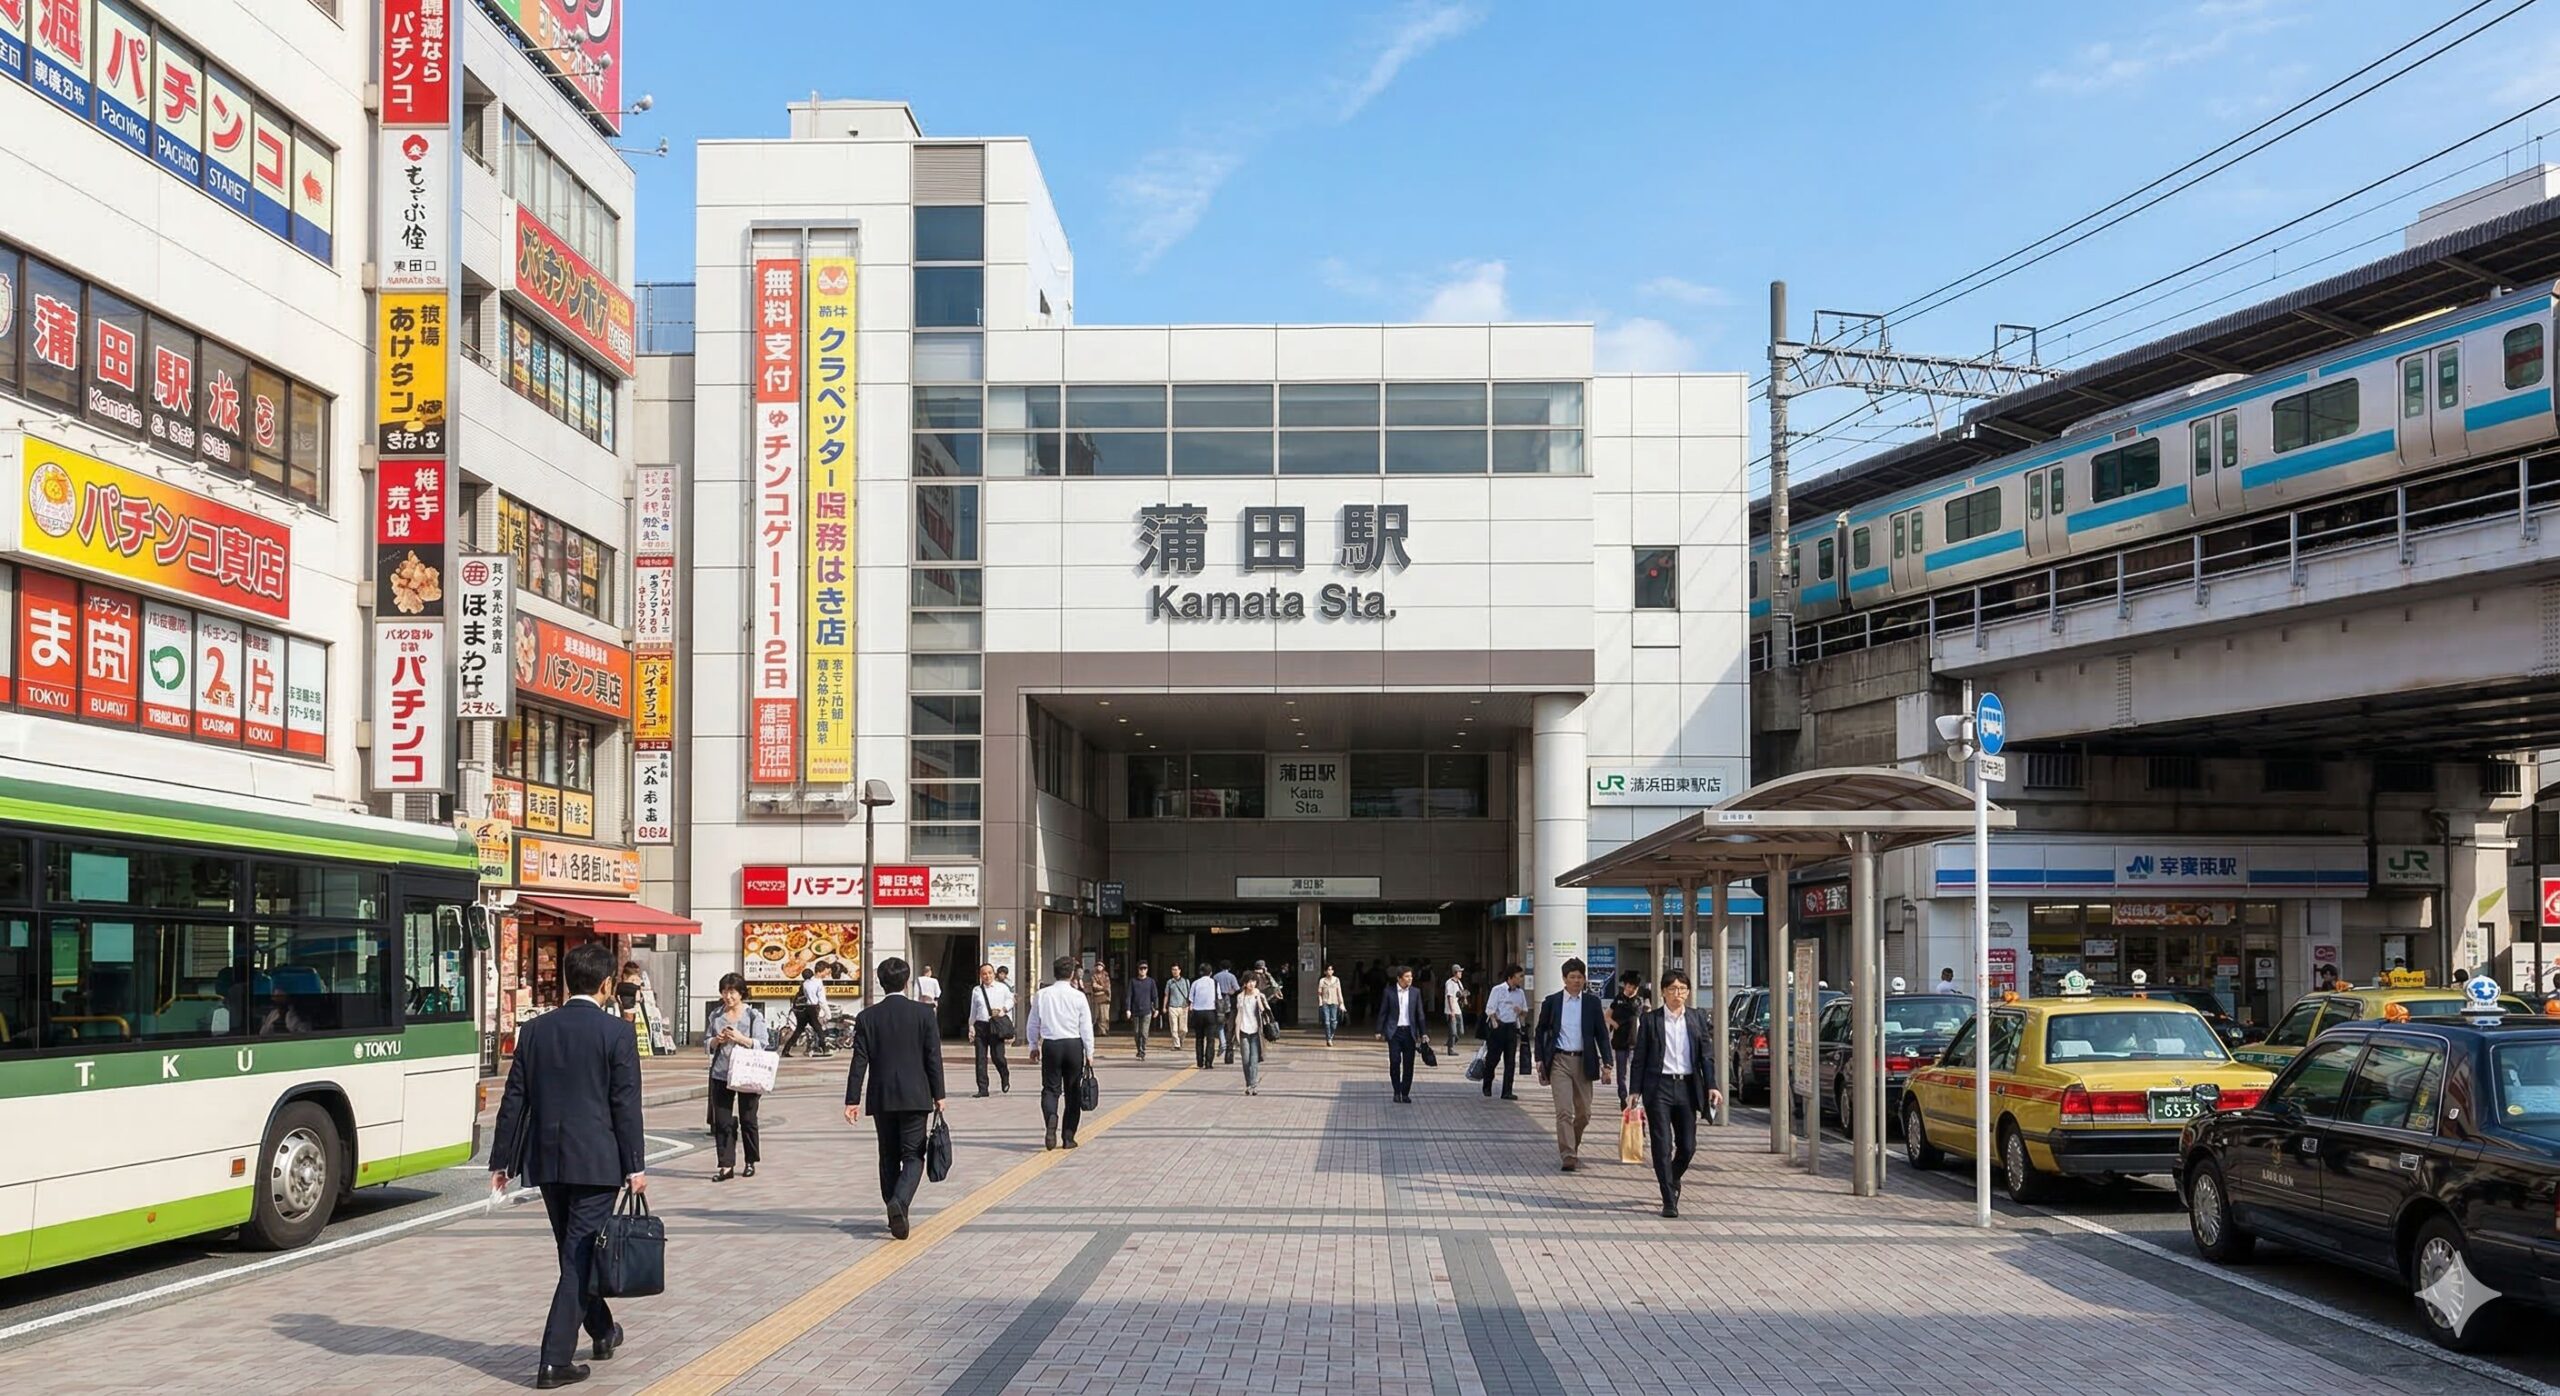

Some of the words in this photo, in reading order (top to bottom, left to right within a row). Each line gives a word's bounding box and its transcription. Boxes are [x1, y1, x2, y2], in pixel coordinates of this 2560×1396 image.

[764, 268, 793, 393] 無料支付
[1137, 502, 1413, 573] 蒲田駅
[1152, 584, 1306, 619] Kamata
[1320, 583, 1397, 619] Sta.
[30, 607, 72, 668] ま
[28, 686, 70, 708] TOKYU
[392, 655, 426, 784] パチンコ
[1596, 775, 1625, 791] JR
[1295, 801, 1322, 814] Sta.
[2388, 850, 2430, 872] JR
[364, 1039, 402, 1057] TOKYU
[74, 1061, 95, 1087] T
[162, 1054, 180, 1078] K
